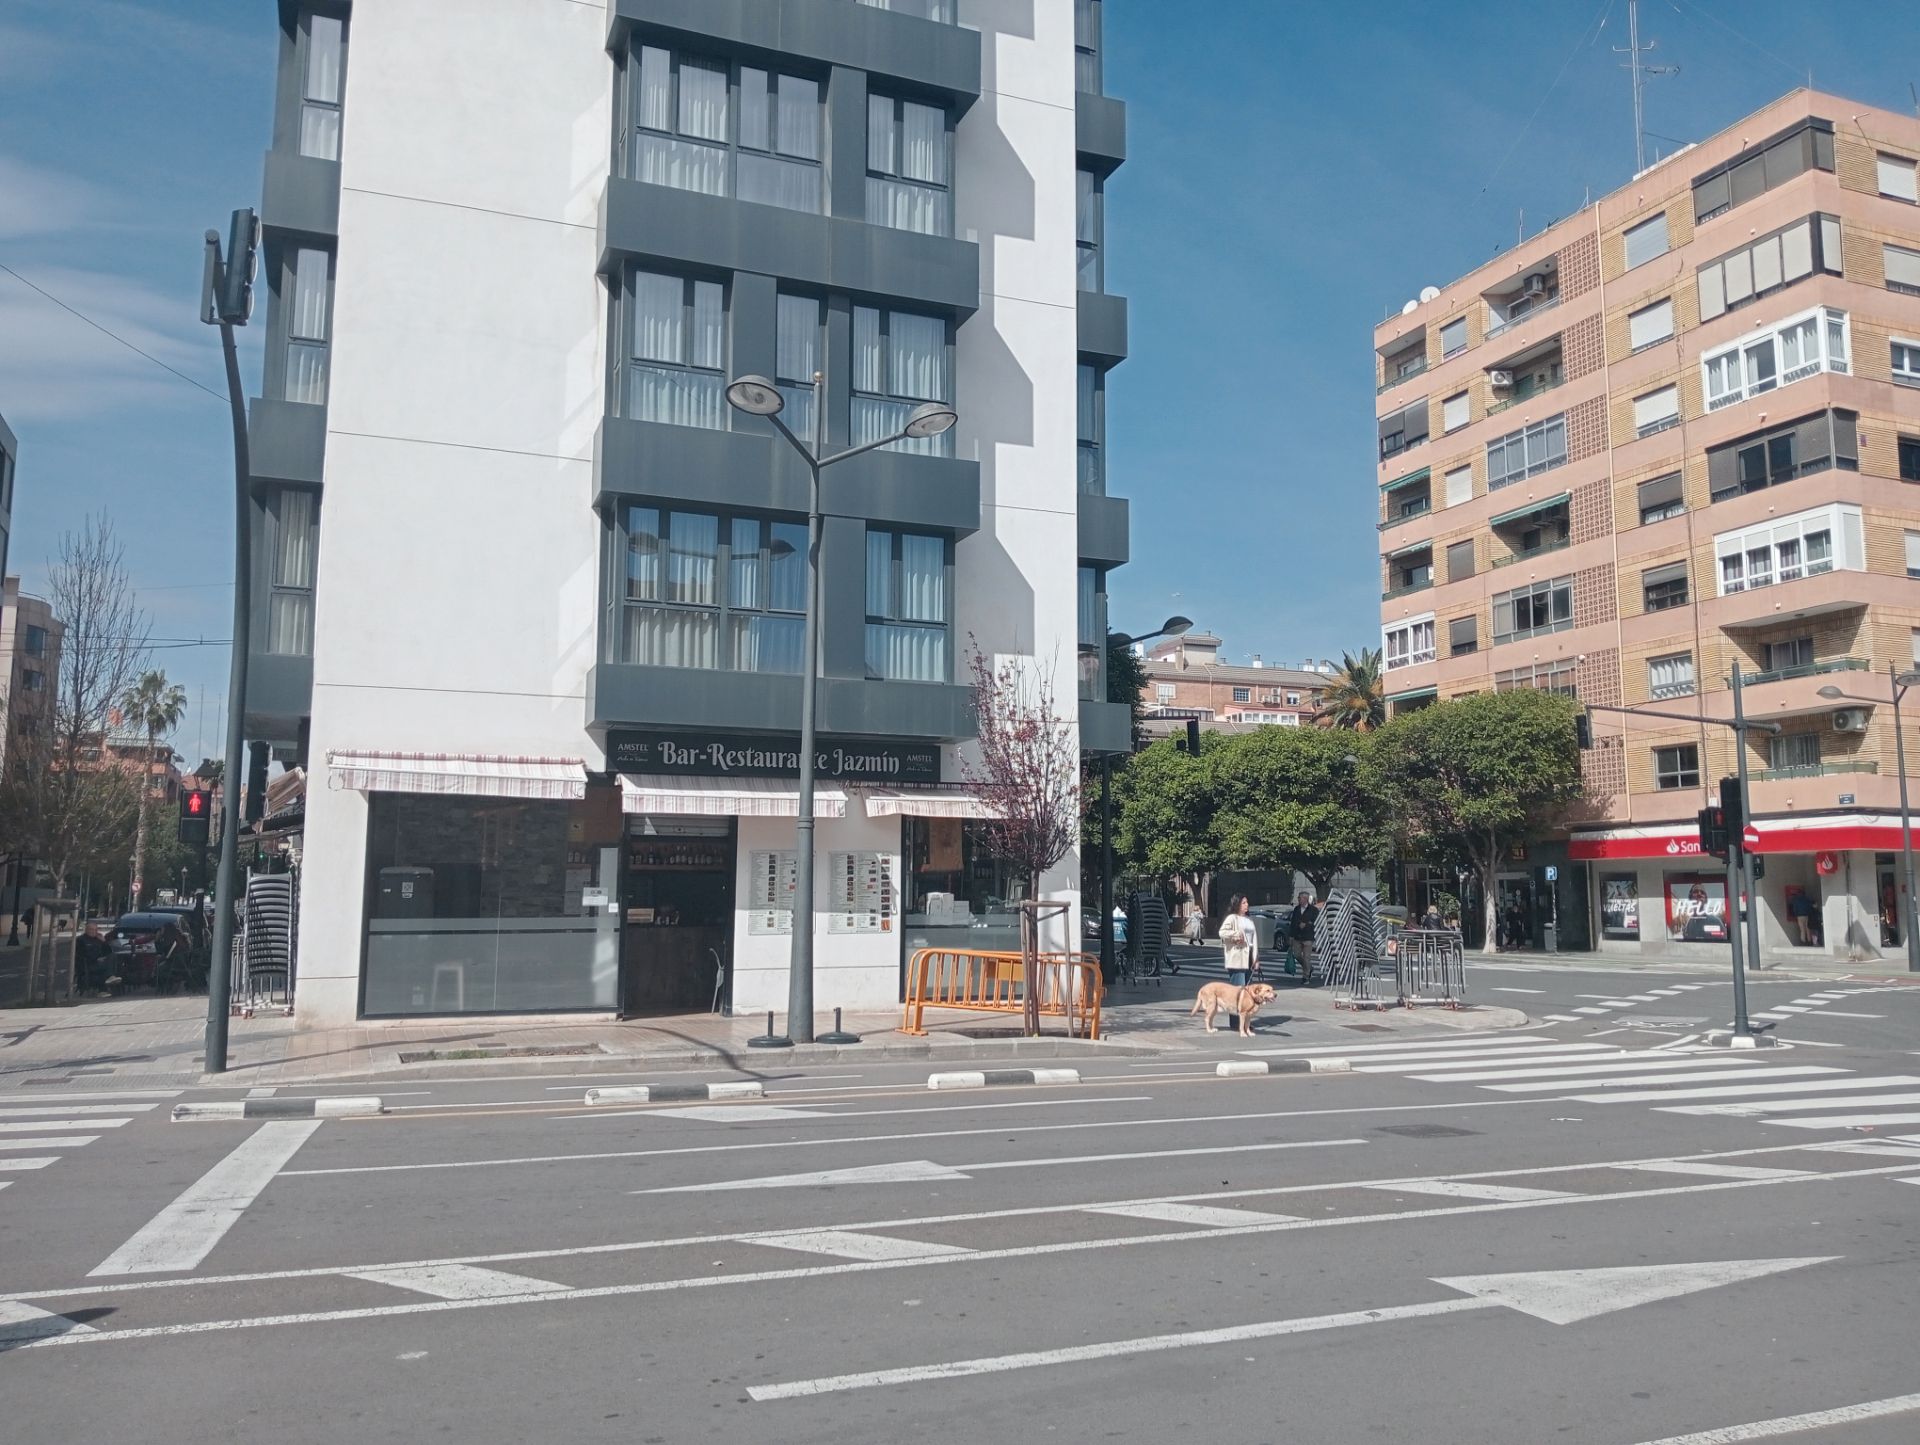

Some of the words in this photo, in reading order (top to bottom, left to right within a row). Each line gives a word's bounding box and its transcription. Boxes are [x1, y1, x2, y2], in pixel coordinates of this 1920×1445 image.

[617, 743, 649, 751] AMSTEL
[657, 741, 829, 770] Bar-Restaurate
[832, 748, 900, 775] Jazmín
[906, 754, 933, 762] AMSTEL
[1675, 899, 1723, 916] HELLO
